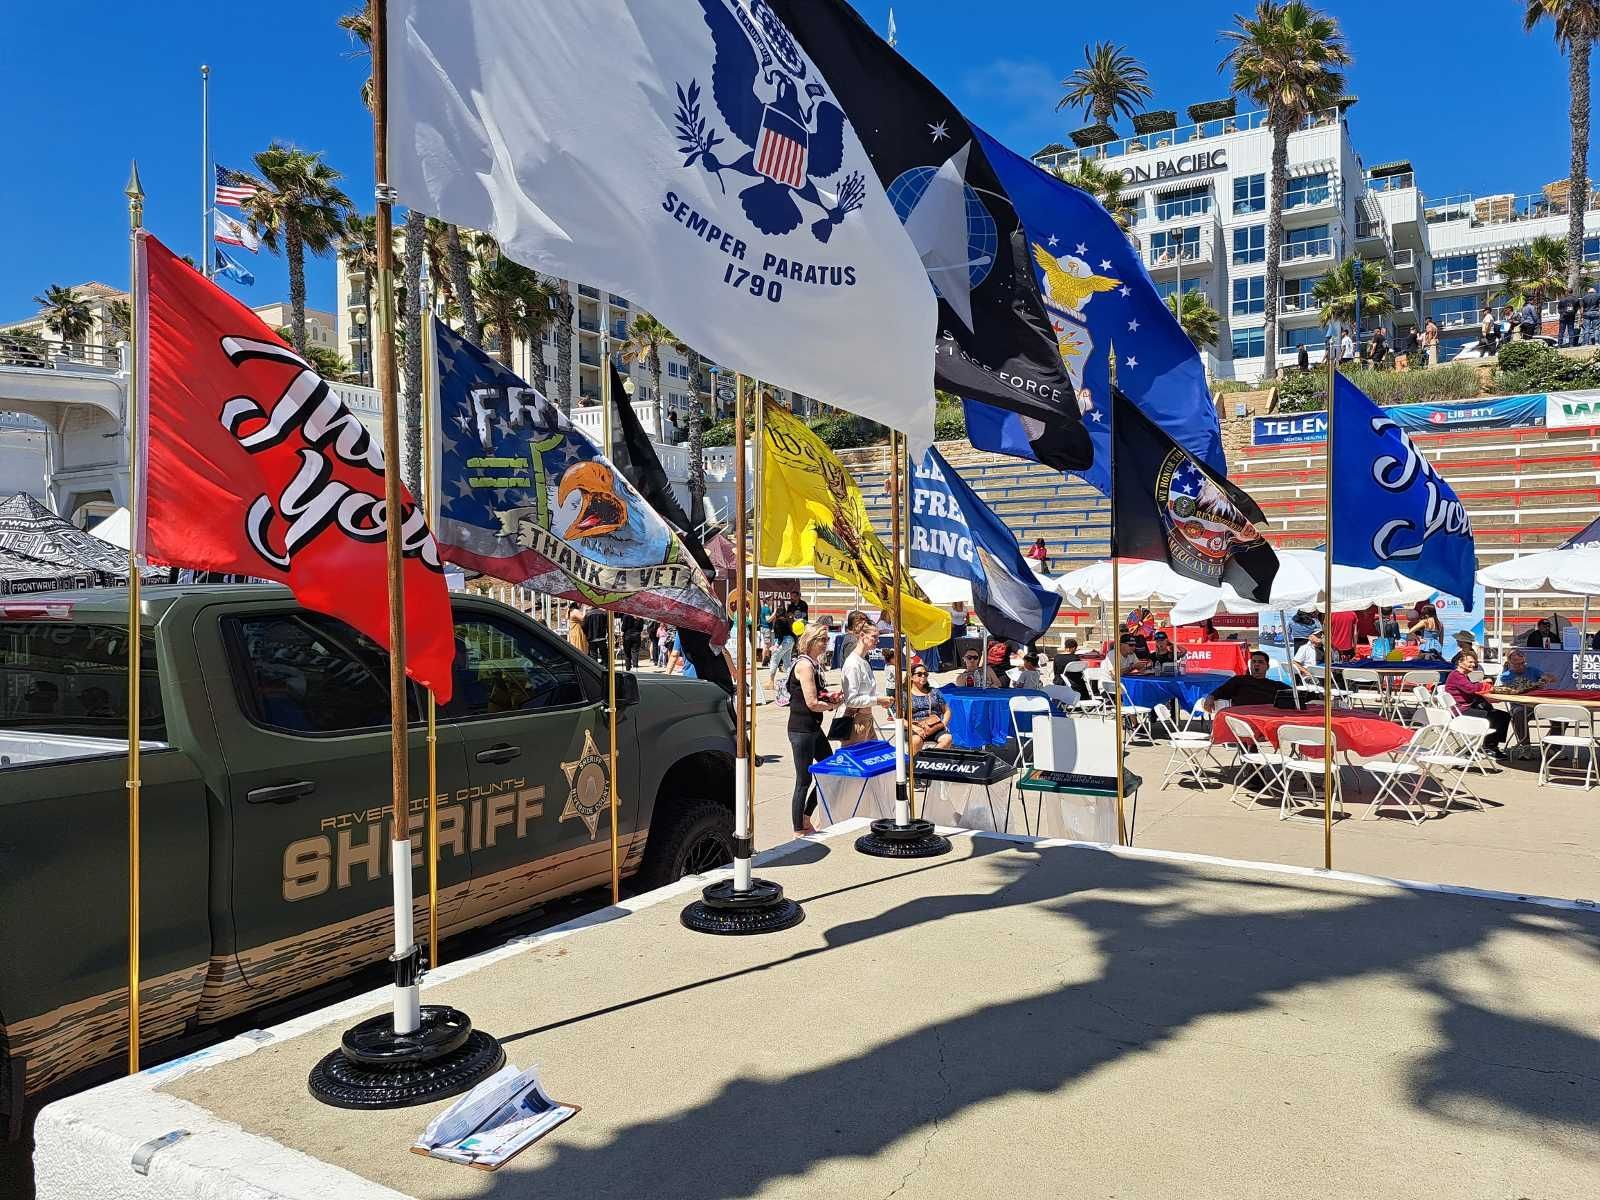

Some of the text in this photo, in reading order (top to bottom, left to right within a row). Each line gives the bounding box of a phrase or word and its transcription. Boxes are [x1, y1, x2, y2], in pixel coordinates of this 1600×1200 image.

[1156, 148, 1227, 178] PACIFIC
[662, 191, 857, 286] SEMPER PARATUS
[723, 263, 783, 303] 1790
[999, 371, 1062, 403] FORCE
[1263, 417, 1328, 436] TELEM
[1447, 407, 1494, 419] LIBERTY
[529, 526, 681, 591] THANK A VET
[912, 525, 974, 563] RING
[11, 582, 58, 593] FRONTWAVE
[1572, 672, 1597, 680] Cedit
[579, 756, 603, 770] SHERIFF
[915, 760, 980, 773] TRASH ONLY
[320, 776, 527, 831] RIVERIE COUNTY
[571, 788, 594, 814] RIVERSIDE
[283, 784, 547, 902] SHERIFF
